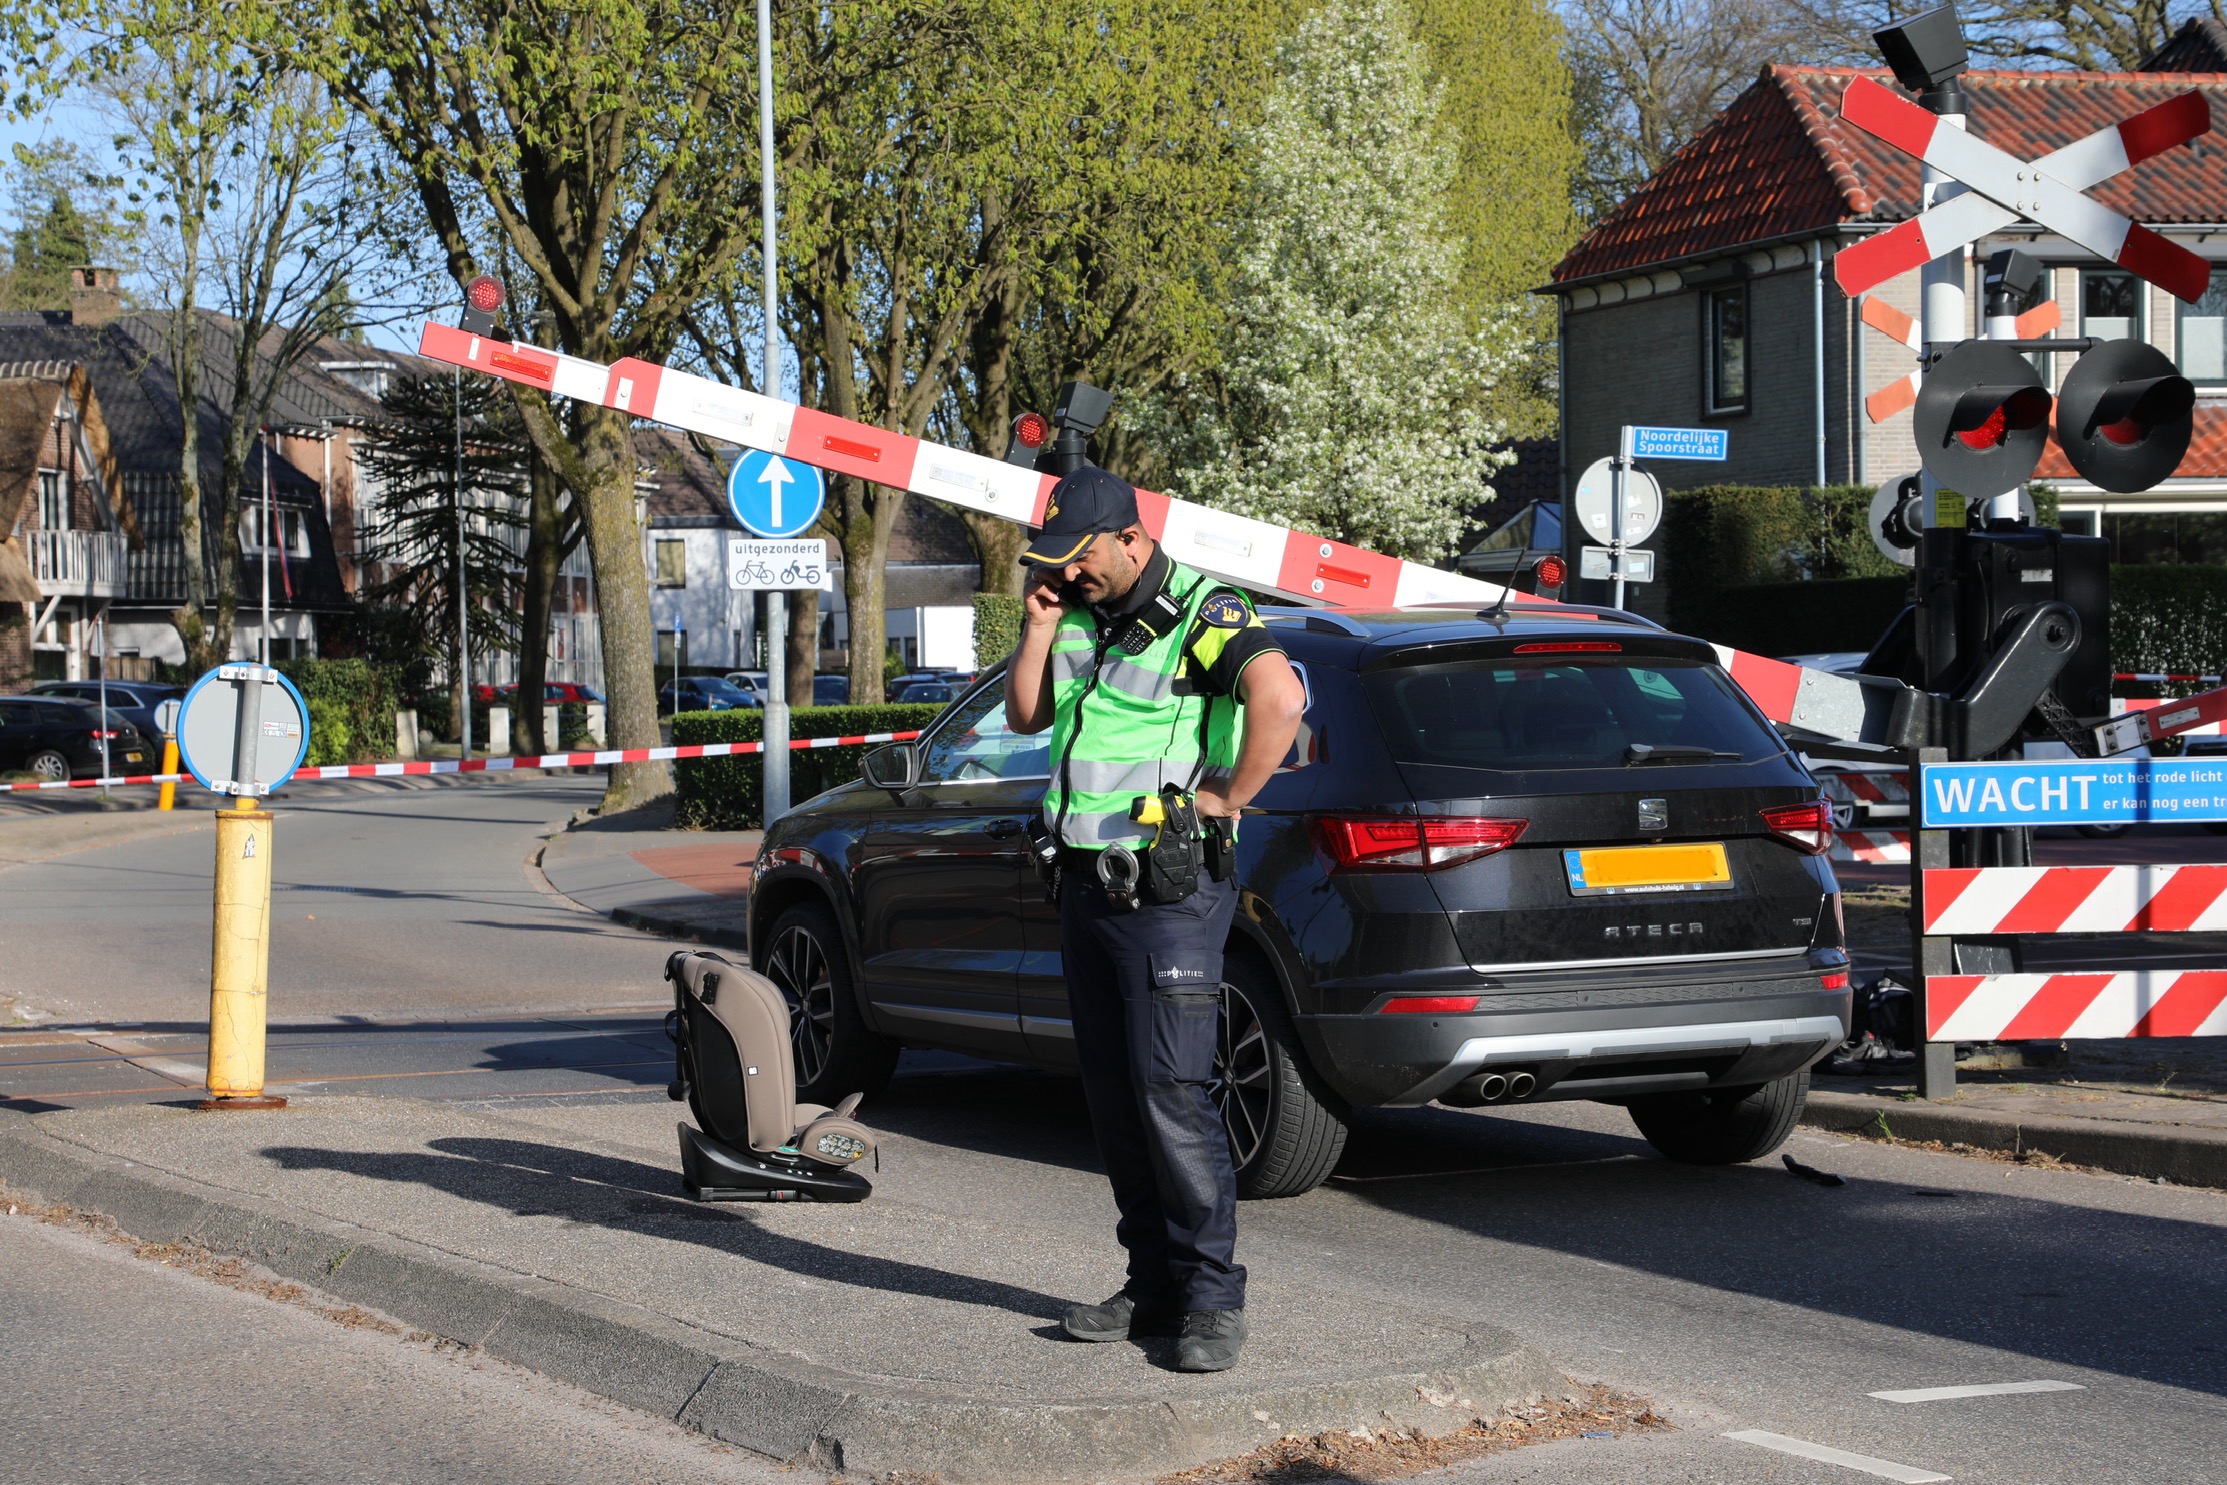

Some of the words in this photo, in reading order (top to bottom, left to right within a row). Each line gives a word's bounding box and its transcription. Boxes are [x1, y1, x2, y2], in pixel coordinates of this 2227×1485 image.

[1640, 430, 1719, 446] Noordelijke
[1639, 441, 1719, 455] Spoorstraat
[735, 543, 820, 556] uitgezonderd
[2103, 773, 2124, 784] tot
[2128, 772, 2151, 783] het
[2155, 771, 2186, 783] rode
[2191, 770, 2223, 782] licht
[1933, 775, 2097, 813] WACHT
[2103, 799, 2118, 809] er
[2122, 797, 2147, 809] kan
[2152, 798, 2178, 811] nog
[2183, 798, 2209, 807] een
[1571, 873, 1584, 882] NL
[1793, 917, 1811, 926] TSI
[1604, 922, 1704, 938] ATECA
